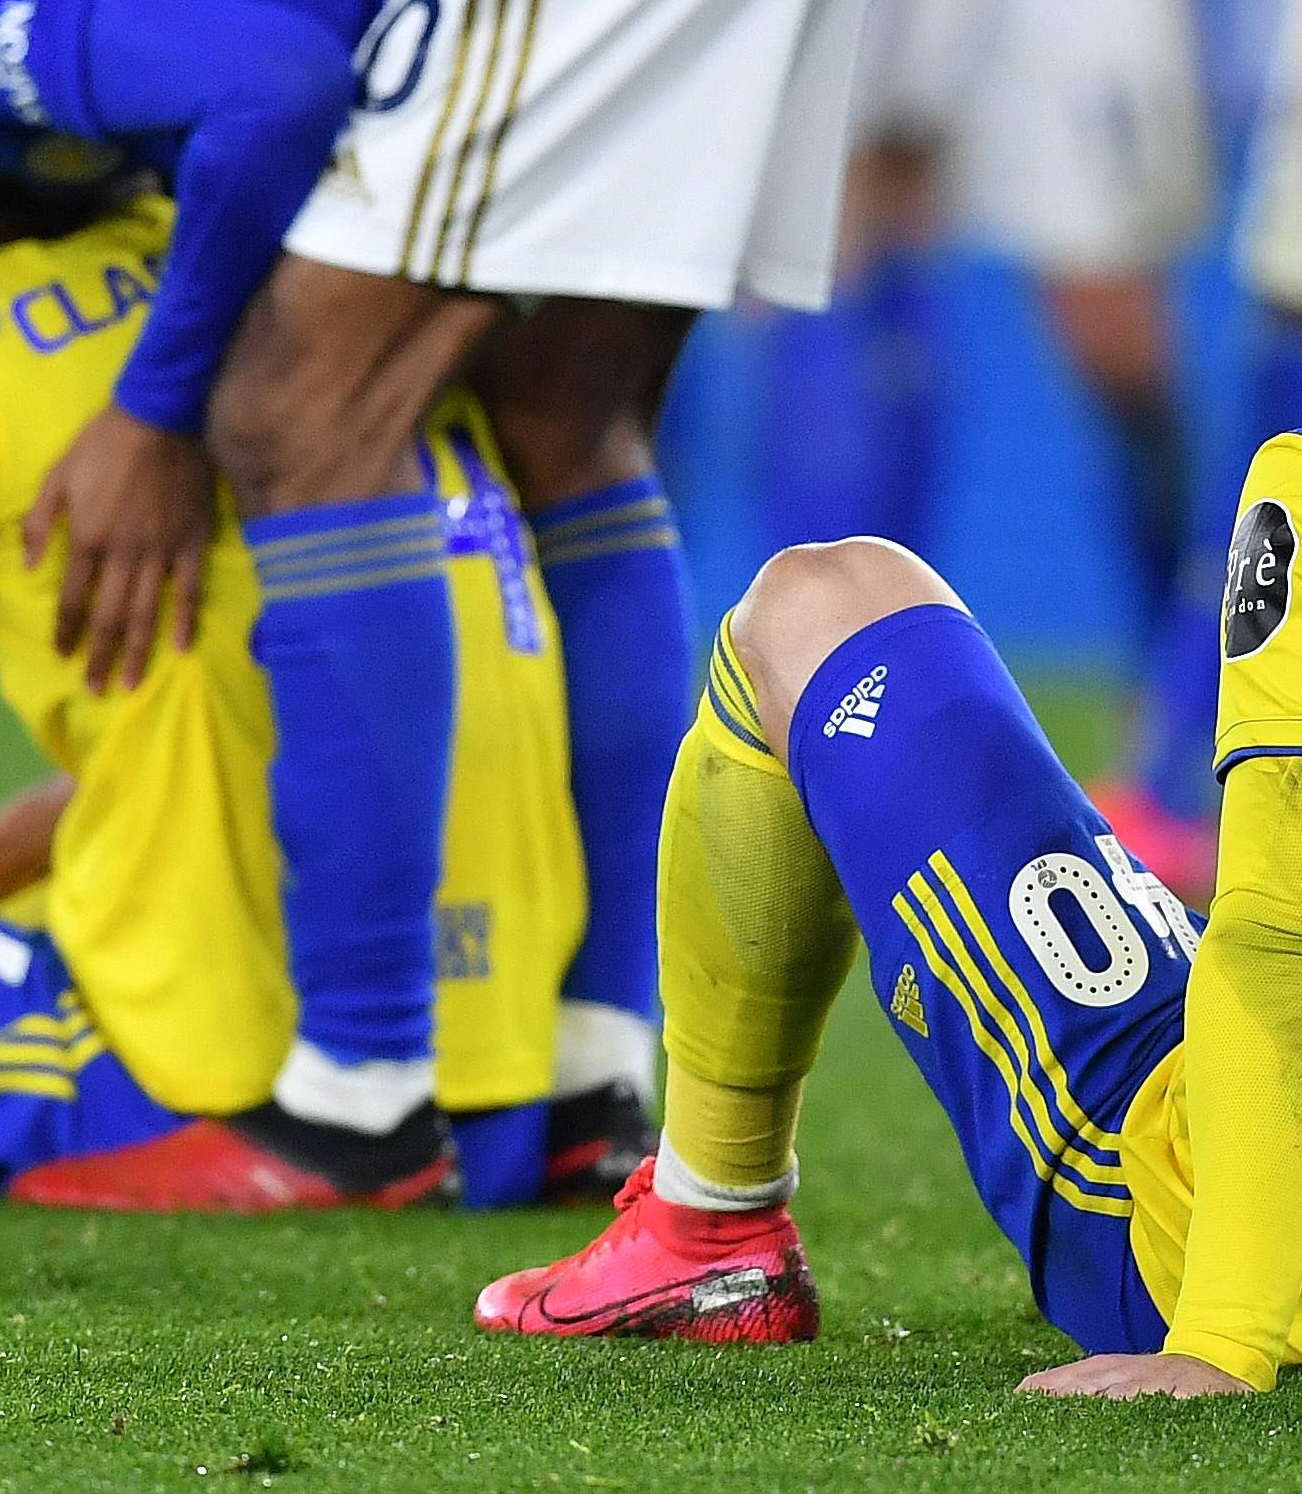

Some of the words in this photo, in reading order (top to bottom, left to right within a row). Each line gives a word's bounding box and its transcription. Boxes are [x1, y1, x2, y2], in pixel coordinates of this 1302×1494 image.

[10, 255, 163, 354] CLA
[1227, 598, 1266, 622] ndon
[823, 665, 888, 738] adidas
